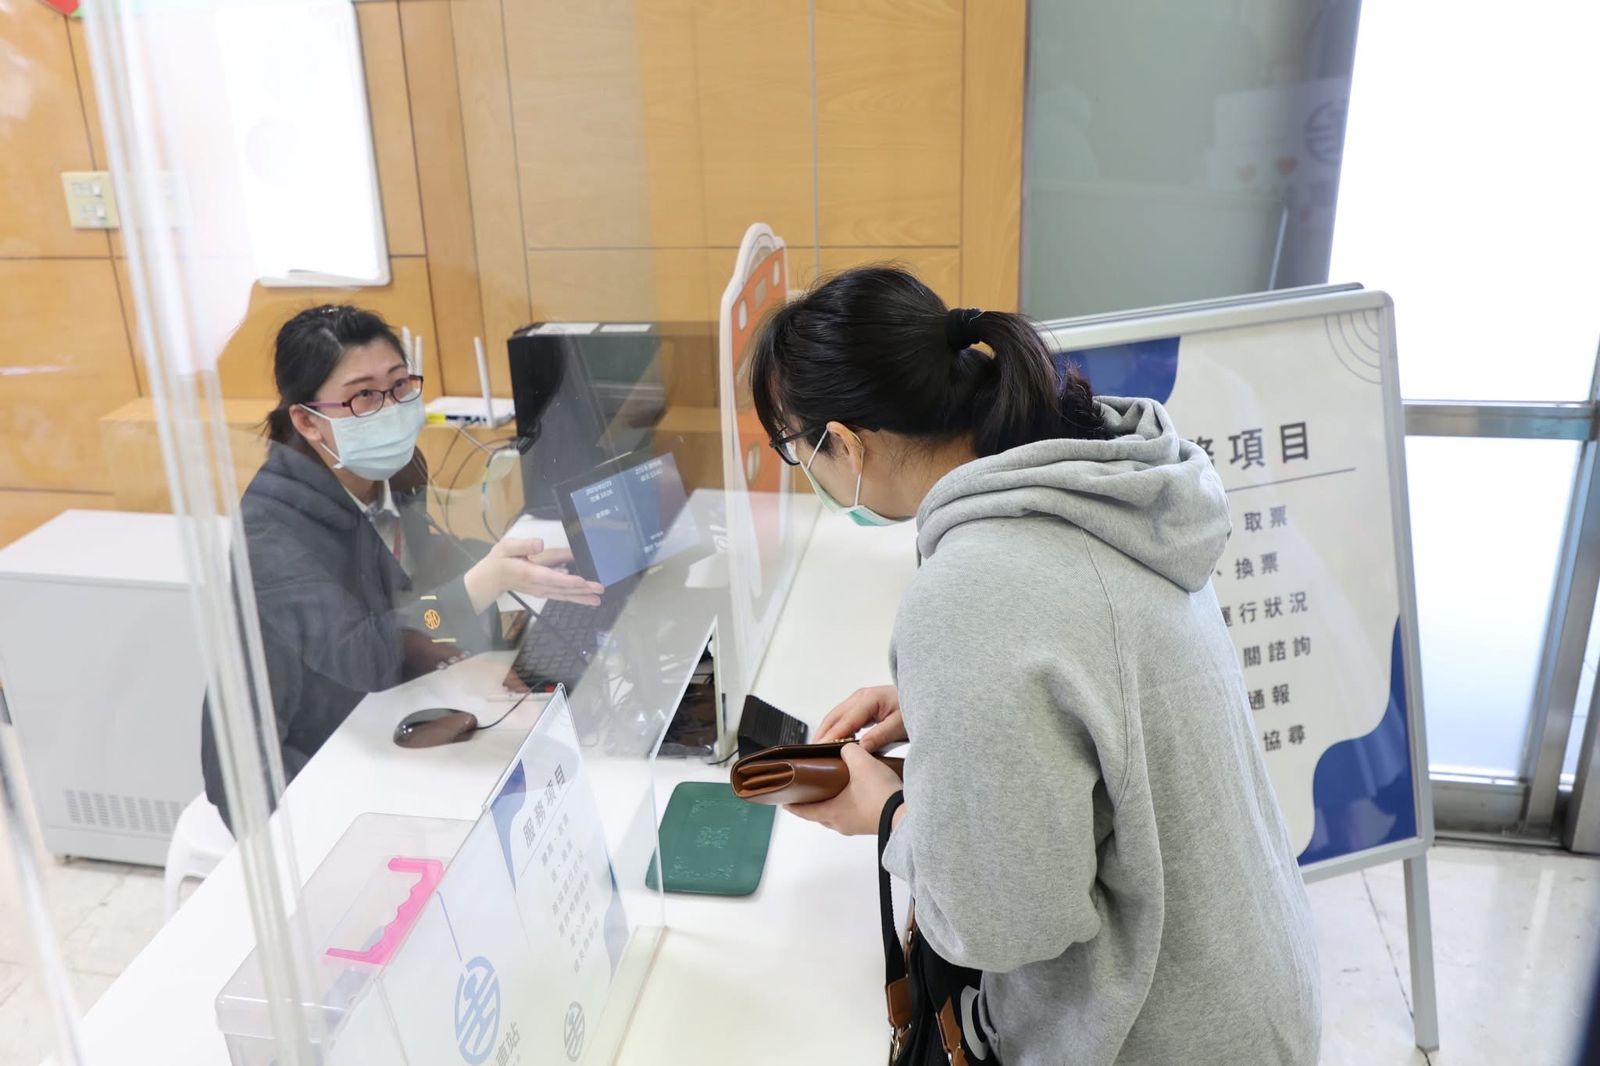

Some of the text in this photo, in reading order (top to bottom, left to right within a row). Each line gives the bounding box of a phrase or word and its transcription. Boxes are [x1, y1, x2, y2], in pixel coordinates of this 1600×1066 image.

[1244, 505, 1287, 532] 取票
[1248, 684, 1290, 711] 通報
[1263, 724, 1305, 752] 協尋
[523, 763, 566, 849] 服務項目
